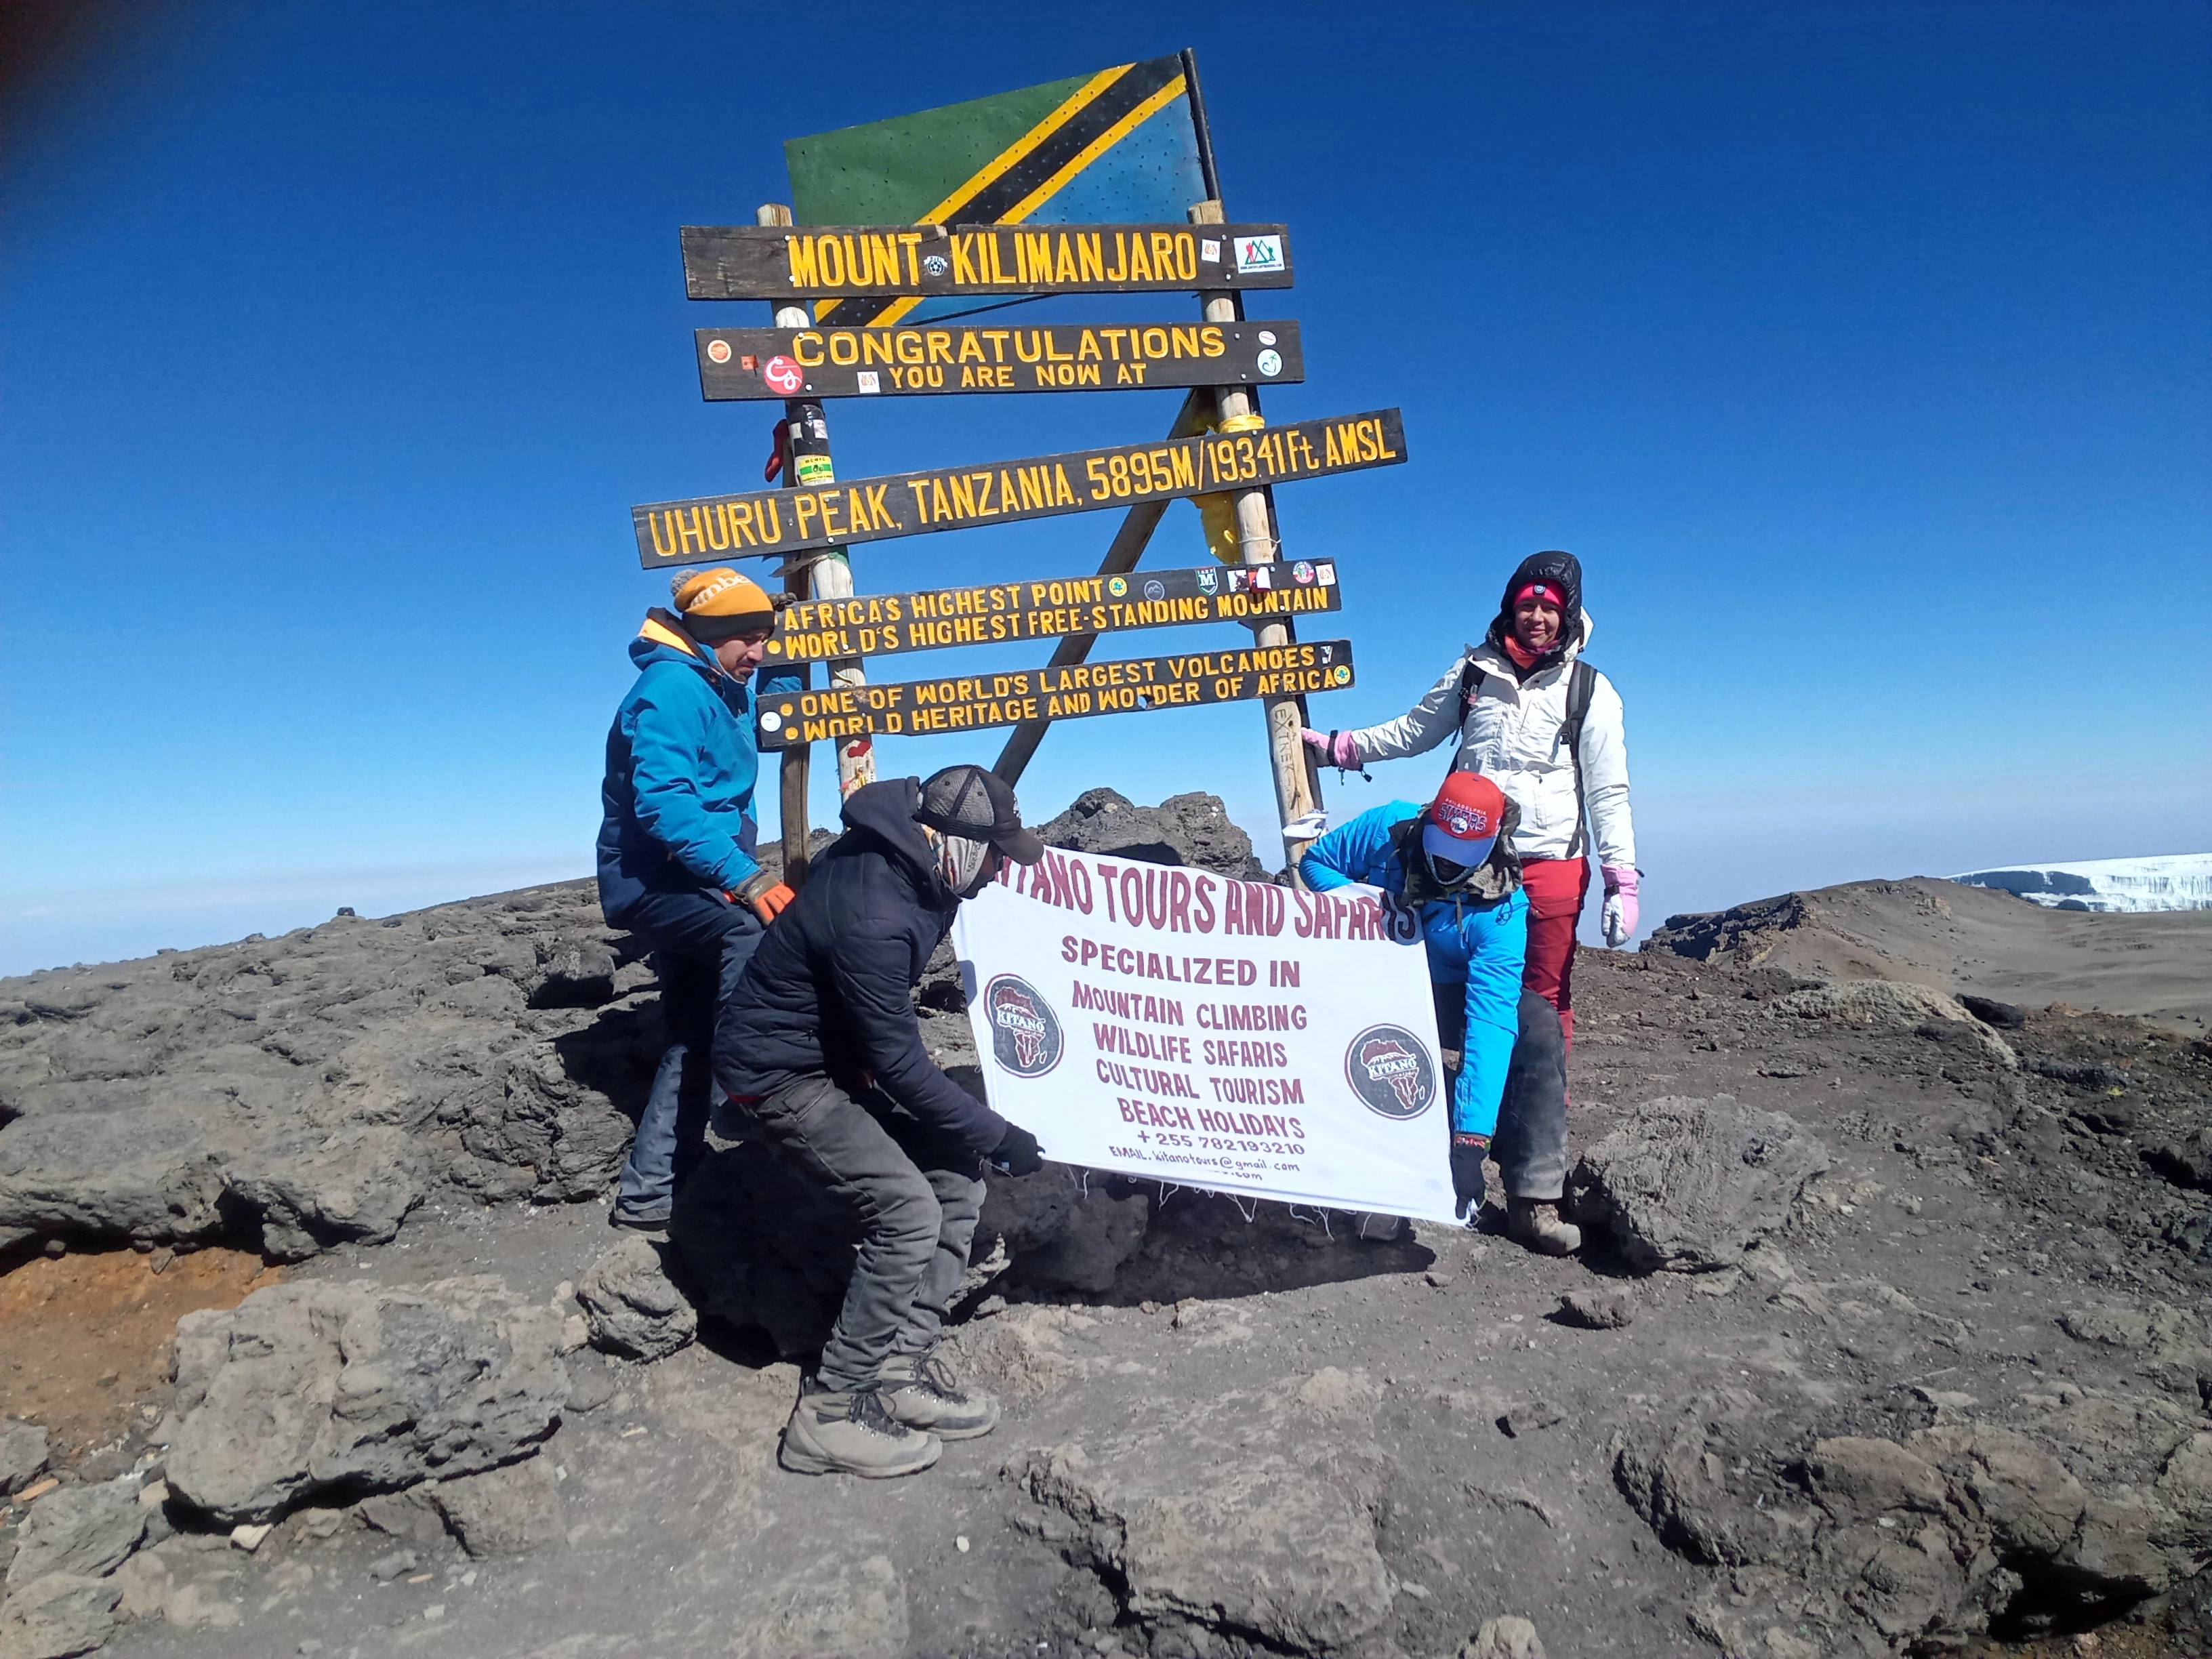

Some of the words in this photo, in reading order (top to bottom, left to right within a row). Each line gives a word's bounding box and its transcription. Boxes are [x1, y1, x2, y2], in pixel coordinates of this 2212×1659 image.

[788, 233, 922, 287] MOUNT
[950, 232, 1197, 284] KILIMANJARO
[793, 327, 1225, 366] CONGRATULATIONS
[888, 366, 944, 388] YOU
[961, 366, 1015, 388] ARE
[1036, 363, 1101, 386] NOW
[1117, 363, 1147, 384] AT
[649, 498, 782, 556] UHURU
[794, 483, 903, 540] PEAK,
[907, 463, 1082, 524] TANZANIA,
[1326, 419, 1396, 468] AMSL
[784, 597, 902, 631] AFRICA'S
[910, 586, 1021, 619] HIGHEST
[1031, 579, 1103, 607] POINT
[785, 625, 899, 660] WORLD'S
[909, 613, 1020, 647] HIGHEST
[1216, 587, 1328, 617] MOUNTAIN
[801, 691, 858, 716] ONE
[869, 687, 903, 710] OF
[916, 675, 1029, 705] WORLD'S
[1040, 661, 1156, 693] LARGEST
[1168, 646, 1315, 679] VOLCANOES
[912, 697, 1038, 731] HERITAGE
[1048, 692, 1091, 717] AND
[1215, 677, 1245, 699] OF
[1258, 668, 1336, 694] AFRICA
[1438, 803, 1488, 832] SIXERS
[1445, 798, 1486, 815] PHILADELPHIA
[1097, 863, 1216, 934] TOURS
[1225, 879, 1284, 937] AND
[1061, 935, 1256, 986] SPECIALIZED
[1270, 960, 1300, 987] IN
[997, 1010, 1045, 1031] KITANO
[1071, 980, 1184, 1026] MOUNTAIN
[1196, 1004, 1307, 1031] CLIMBING
[1092, 1023, 1191, 1064] WILDLIFE
[1203, 1040, 1288, 1067] SAFARIS
[1368, 1058, 1417, 1077] KITANO
[1096, 1059, 1200, 1099] CULTURAL
[1209, 1077, 1305, 1105] TOURISM
[1117, 1097, 1195, 1131] BEACH
[1197, 1109, 1305, 1139] HOLIDAYS
[1198, 1136, 1305, 1155] 782193210
